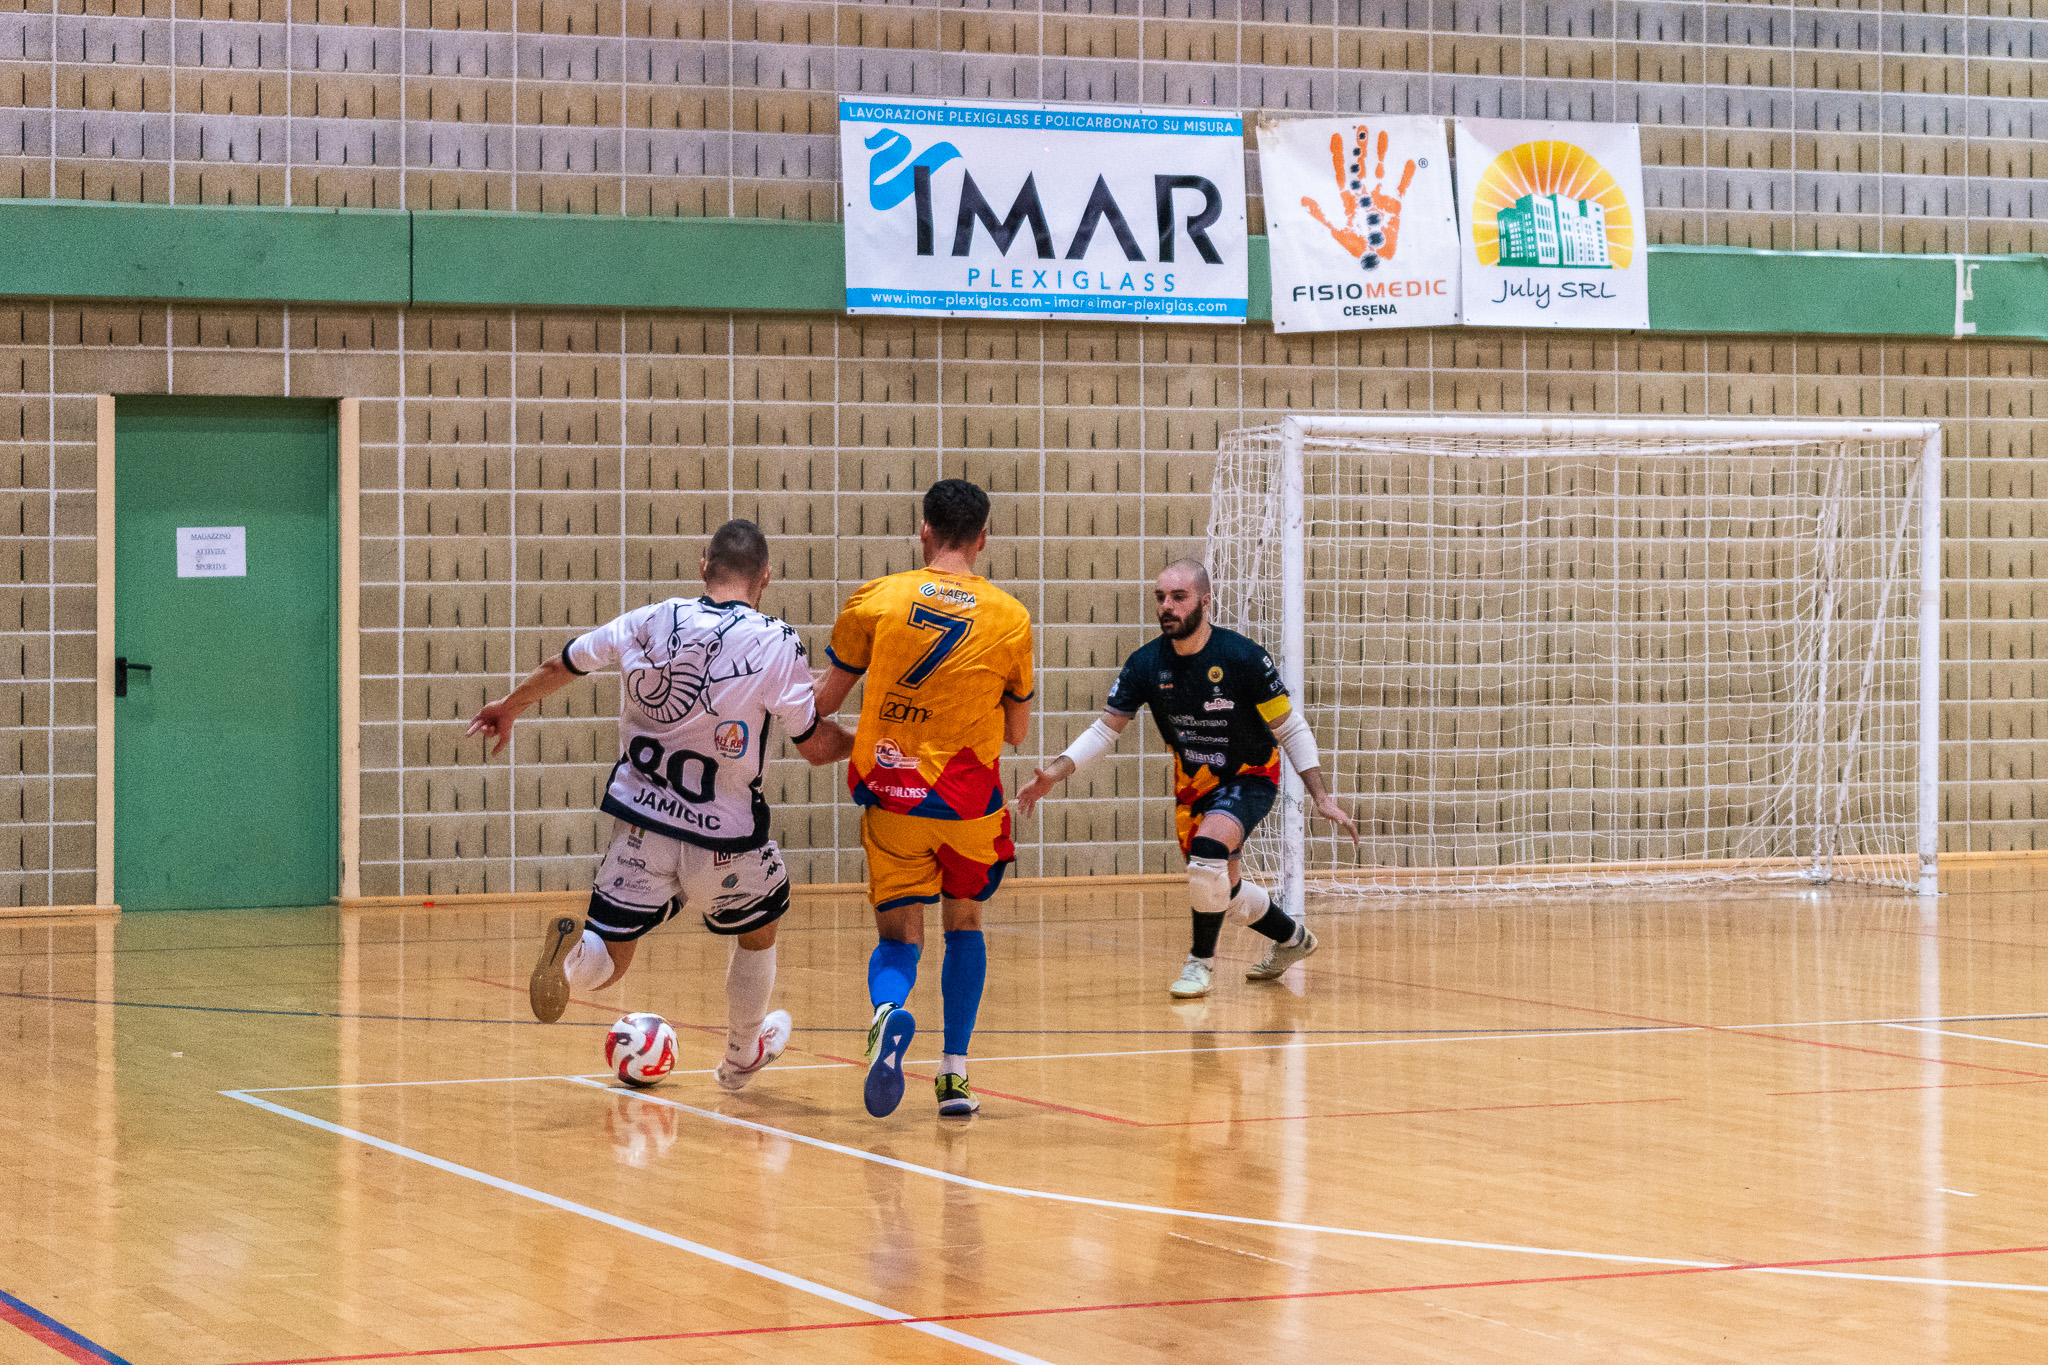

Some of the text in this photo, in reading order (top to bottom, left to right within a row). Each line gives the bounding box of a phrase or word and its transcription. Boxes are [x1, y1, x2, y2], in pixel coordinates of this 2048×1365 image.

[849, 106, 1234, 133] LAVORAZIONE PLEXIGLASS E POLICARBONATO SU MISURA
[913, 165, 1224, 265] IMAR
[968, 268, 1175, 292] PLEXIGLASS
[1293, 279, 1447, 302] FISIOMEDIC
[871, 292, 1042, 309] www.imar-plexiglas.com
[1054, 296, 1227, 314] imar@imar-plexiglas.com
[1491, 277, 1617, 309] July SRL
[1343, 304, 1398, 316] CESENA
[939, 586, 976, 604] LAERA
[896, 601, 974, 690] 7
[634, 788, 721, 830] JAMICIC
